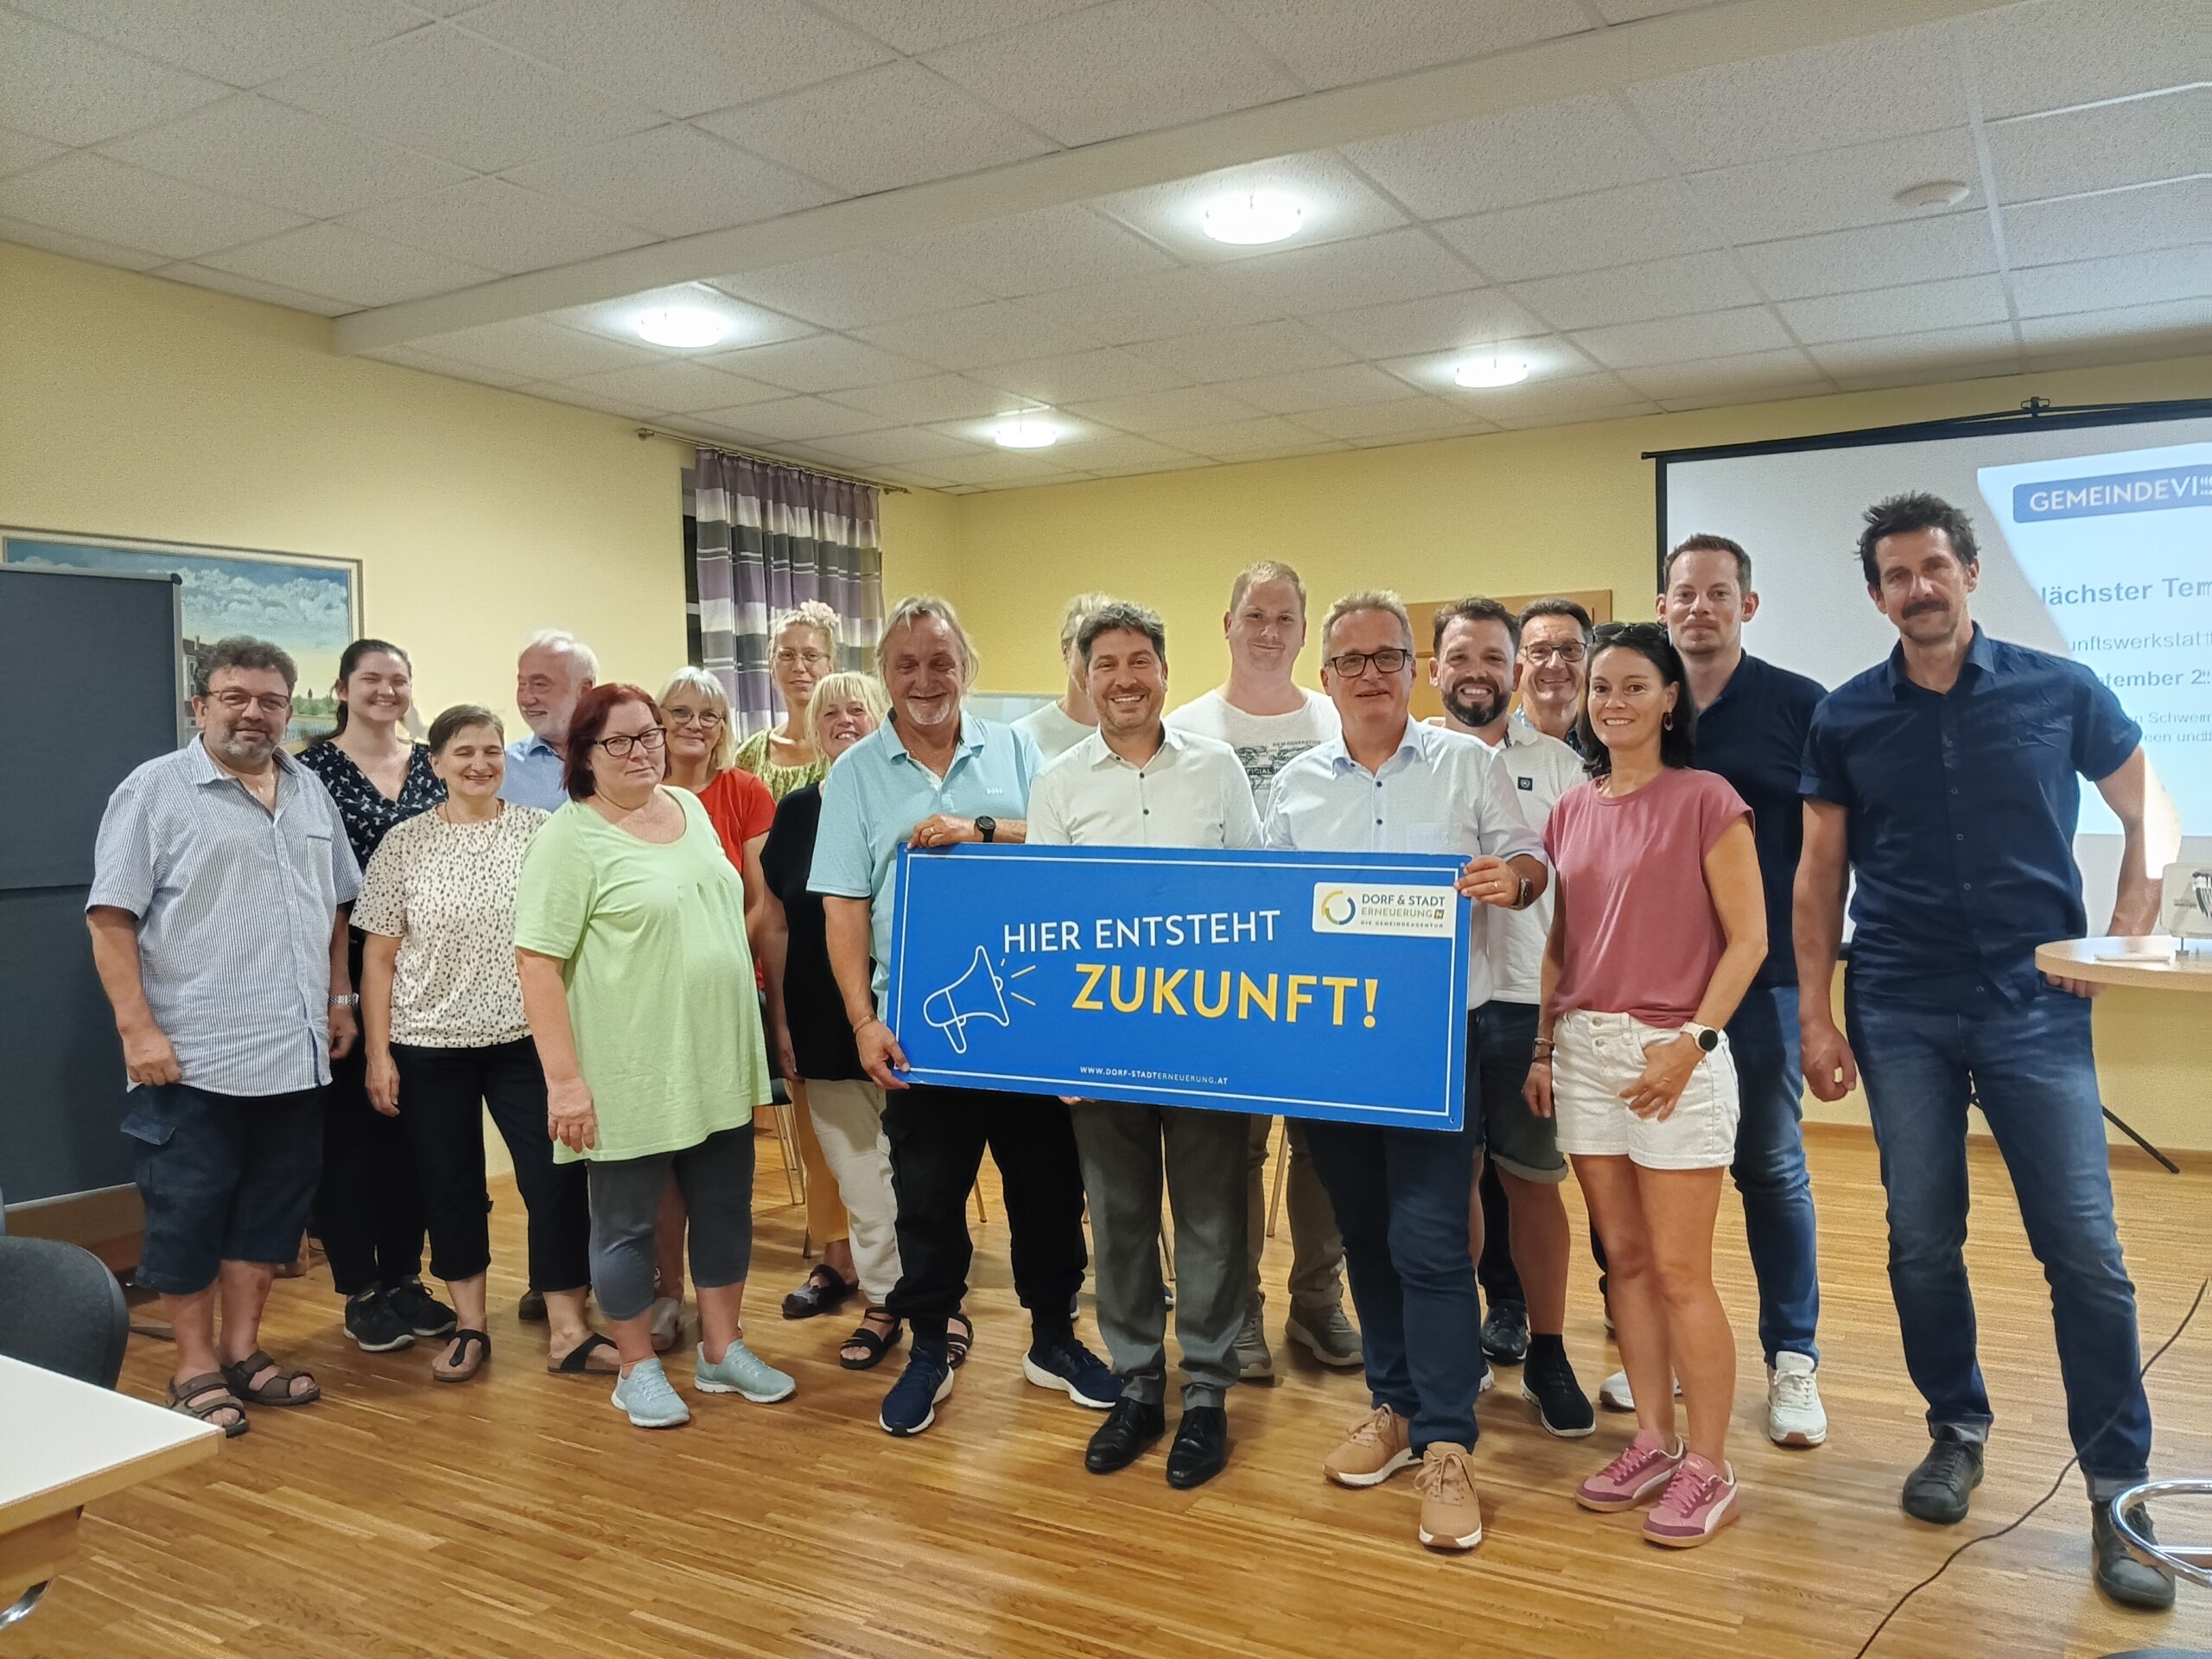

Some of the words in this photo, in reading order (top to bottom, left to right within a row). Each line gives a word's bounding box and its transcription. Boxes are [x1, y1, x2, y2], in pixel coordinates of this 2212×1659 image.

[2102, 671, 2184, 688] tember
[1362, 893, 1395, 905] DORF
[1397, 894, 1406, 905] &
[1408, 895, 1446, 906] STADT
[1361, 907, 1433, 918] ERNEUERUNG
[1004, 921, 1081, 953] HIER
[1096, 910, 1281, 949] ENTSTEHT
[1375, 920, 1444, 929] GEMEINDEAGENTUR
[1071, 963, 1378, 1028] ZUKUNFT!
[1079, 1065, 1228, 1085] WWW.DORF-STADTERNEUERUNG.AT
